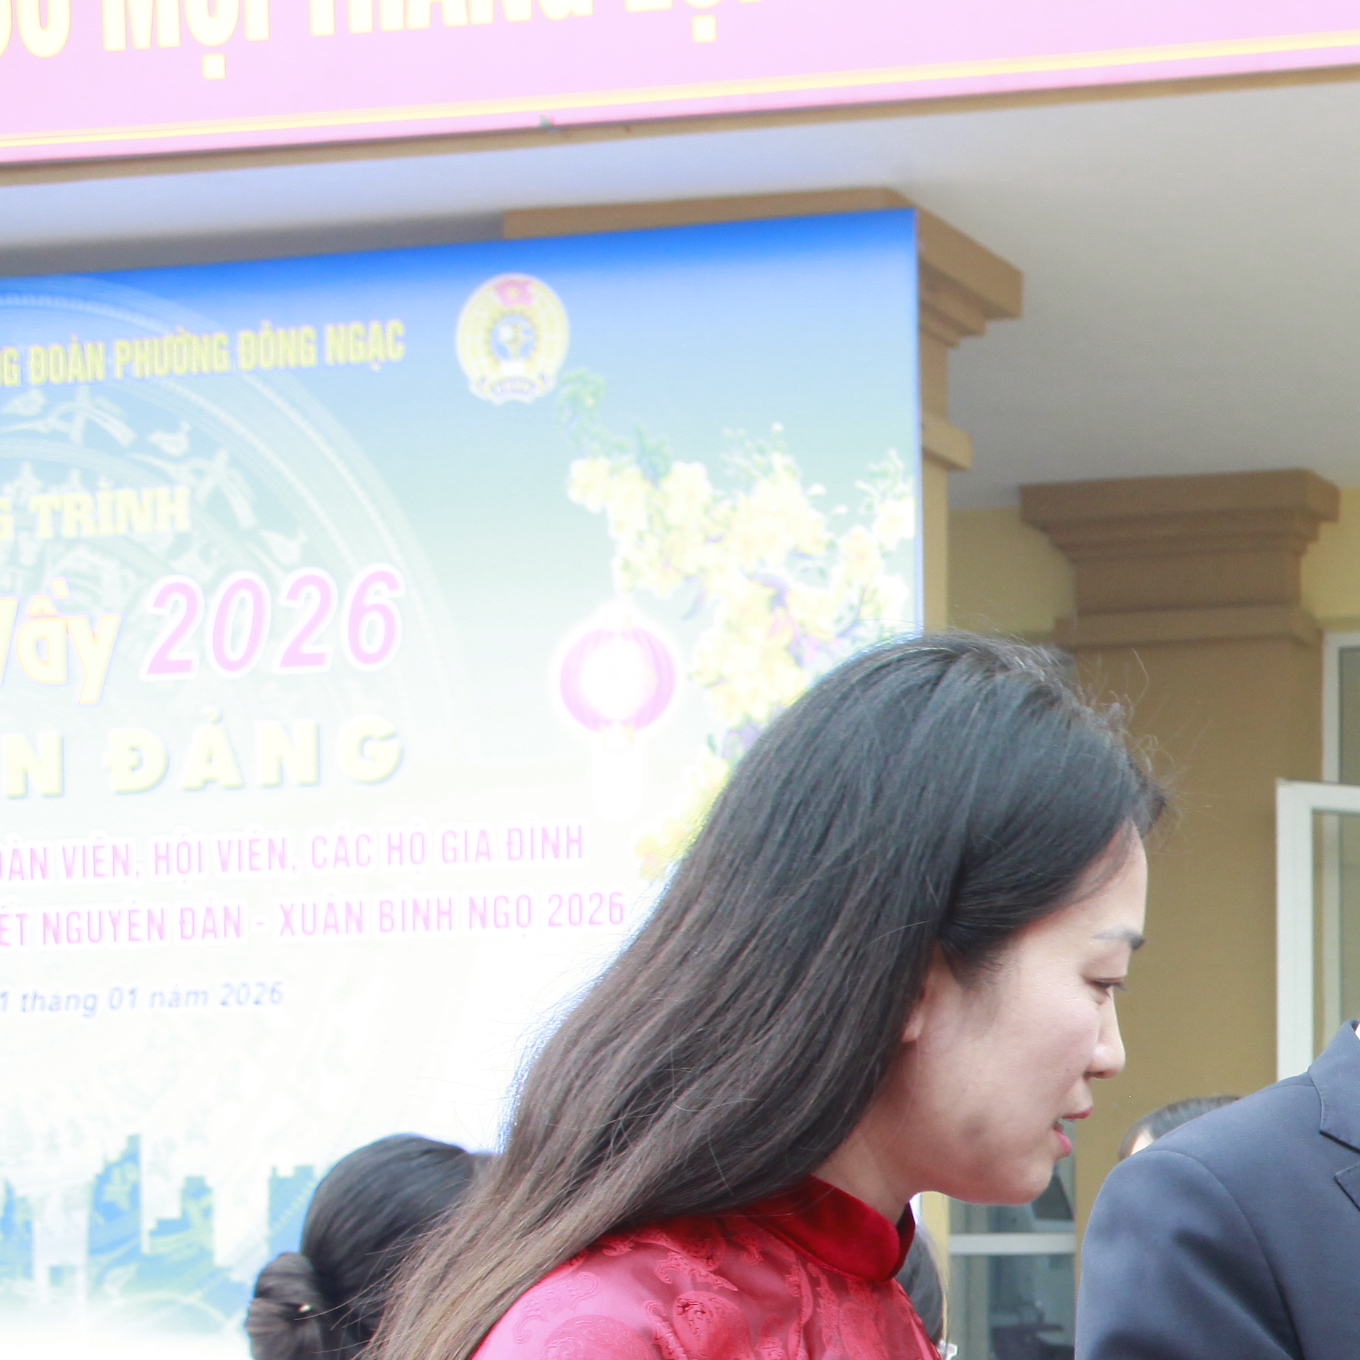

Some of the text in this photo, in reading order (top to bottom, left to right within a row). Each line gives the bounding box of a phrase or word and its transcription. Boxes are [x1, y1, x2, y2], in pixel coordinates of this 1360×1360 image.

[0, 346, 21, 387] G
[29, 334, 106, 385] ĐOÀN
[114, 326, 230, 379] PHƯỜNG
[325, 320, 405, 372] NGẠC
[28, 481, 190, 540] TRÌNH
[142, 564, 405, 679] 2026
[106, 706, 402, 795] ĐẢNG
[0, 838, 49, 882] ÀN
[442, 828, 492, 865] GIA
[42, 899, 165, 946] NGUYÊN
[280, 893, 362, 936] XUÂN
[547, 890, 626, 928] 2026
[20, 989, 100, 1020] tháng
[107, 984, 140, 1011] 01
[149, 983, 209, 1009] năm
[217, 980, 285, 1008] 2026
